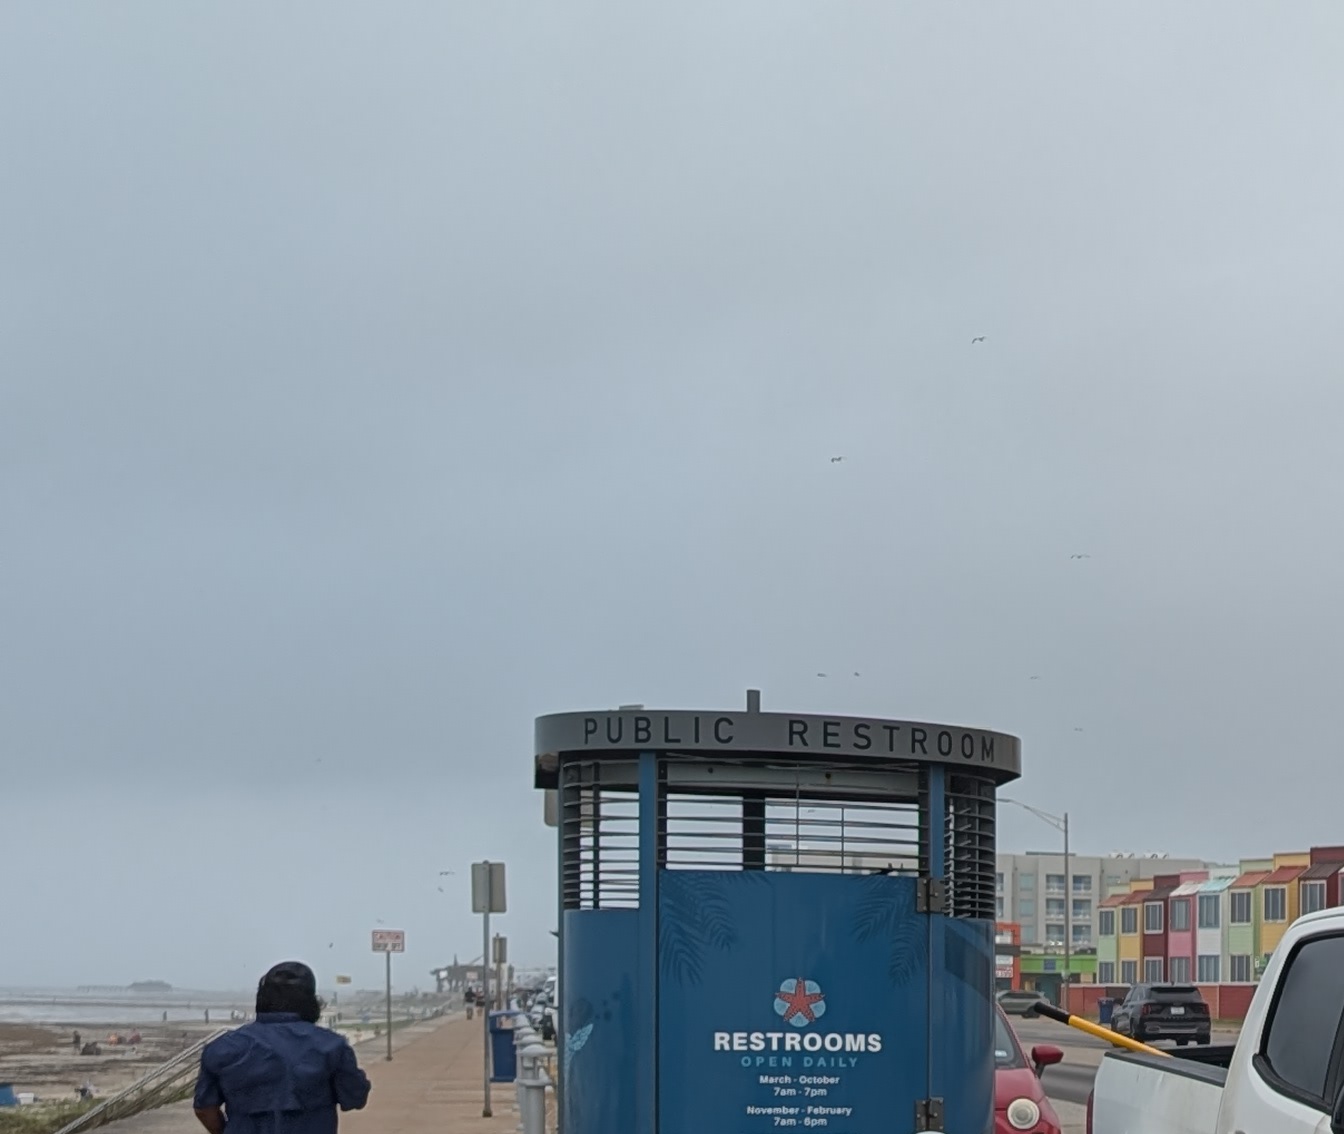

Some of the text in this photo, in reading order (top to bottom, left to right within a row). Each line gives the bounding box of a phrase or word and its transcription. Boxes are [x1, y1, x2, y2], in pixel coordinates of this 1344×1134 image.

[584, 716, 996, 763] PUBLIC RESTROOM
[714, 1032, 882, 1052] RESTROOMS
[741, 1056, 858, 1067] OPEN DAILY
[759, 1075, 791, 1084] March
[799, 1075, 840, 1084] October
[774, 1087, 796, 1096] 7am
[804, 1087, 827, 1097] 7pm
[746, 1105, 800, 1114] November
[806, 1106, 852, 1116] February
[774, 1117, 796, 1126] 7am
[804, 1117, 827, 1127] 6pm
